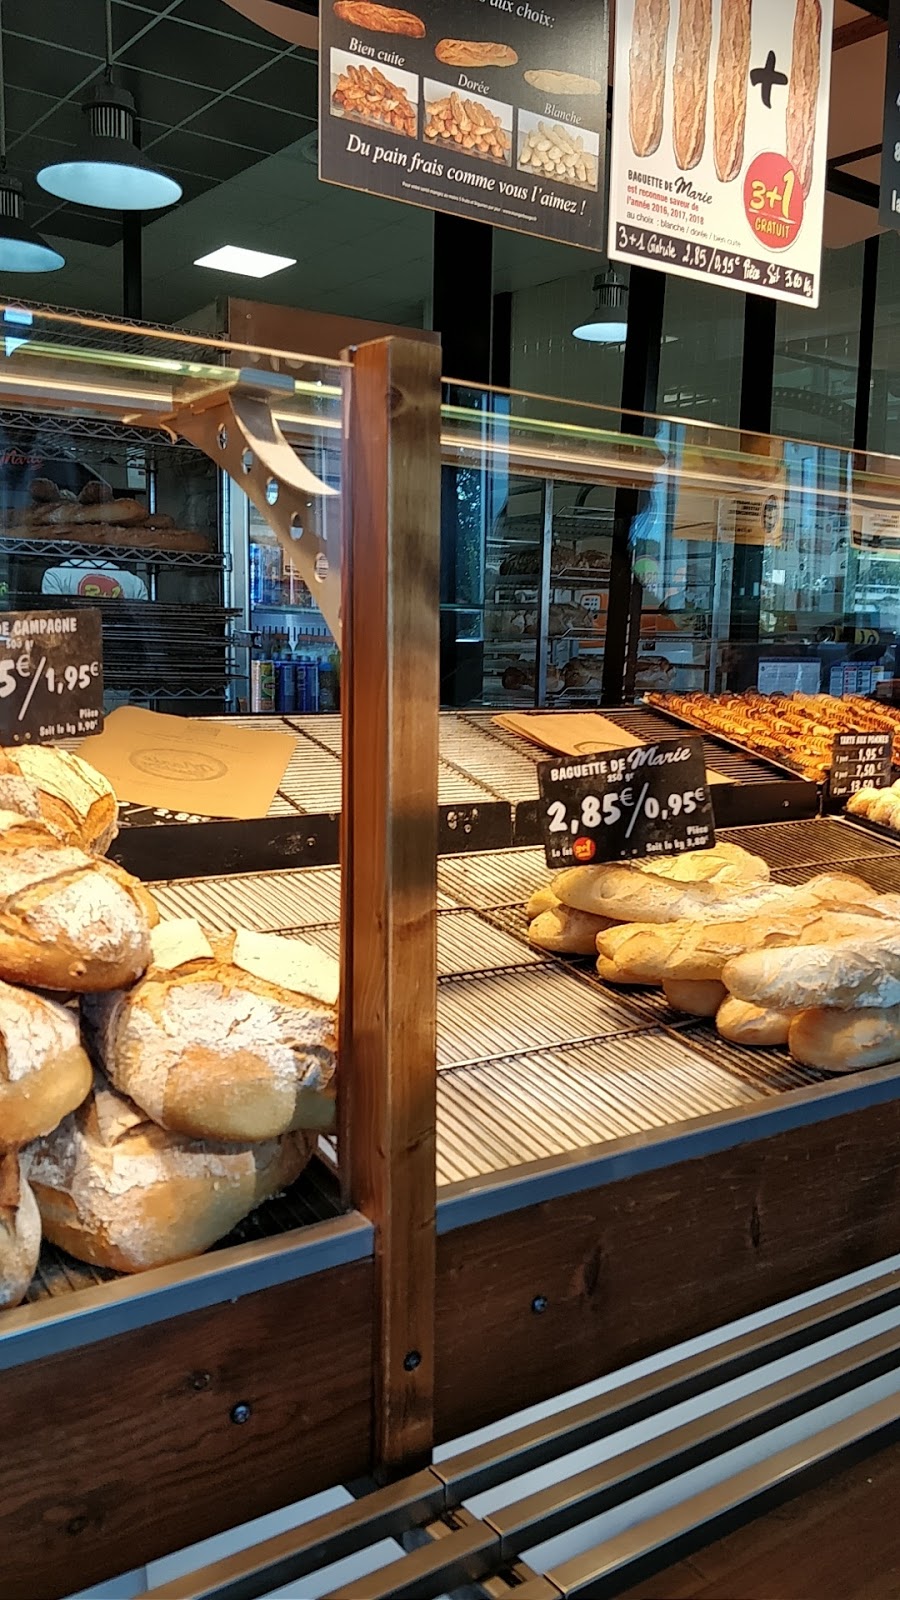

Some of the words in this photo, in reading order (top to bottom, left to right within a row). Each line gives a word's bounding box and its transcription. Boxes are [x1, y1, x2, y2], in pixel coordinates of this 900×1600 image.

[516, 3, 555, 29] choix:
[349, 37, 375, 58] Bien
[377, 47, 405, 67] cuite
[458, 73, 490, 95] Dorée
[544, 103, 582, 125] Blanche
[346, 134, 370, 155] Du
[372, 144, 407, 167] pain
[407, 152, 443, 179] frais
[446, 164, 495, 191] comme
[498, 180, 527, 201] vous
[627, 185, 637, 195] est
[639, 188, 668, 203] reconnue
[670, 198, 690, 209] saveur
[691, 201, 699, 212] de
[628, 169, 663, 189] BAGUETTE
[664, 180, 673, 192] DE
[674, 176, 713, 204] Marie
[627, 195, 650, 210] l'année
[651, 203, 669, 217] 2016,
[670, 208, 687, 222] 2017,
[689, 213, 704, 225] 2018
[627, 211, 635, 220] au
[636, 213, 654, 225] choix
[661, 219, 685, 233] blanche
[754, 217, 791, 238] GRATUIT
[14, 617, 77, 636] CAMPAGNE
[66, 722, 76, 735] kg
[551, 762, 608, 782] BAGUETTE
[611, 758, 626, 772] DE
[627, 745, 692, 770] Marie
[607, 773, 623, 783] 250
[625, 772, 635, 783] gr
